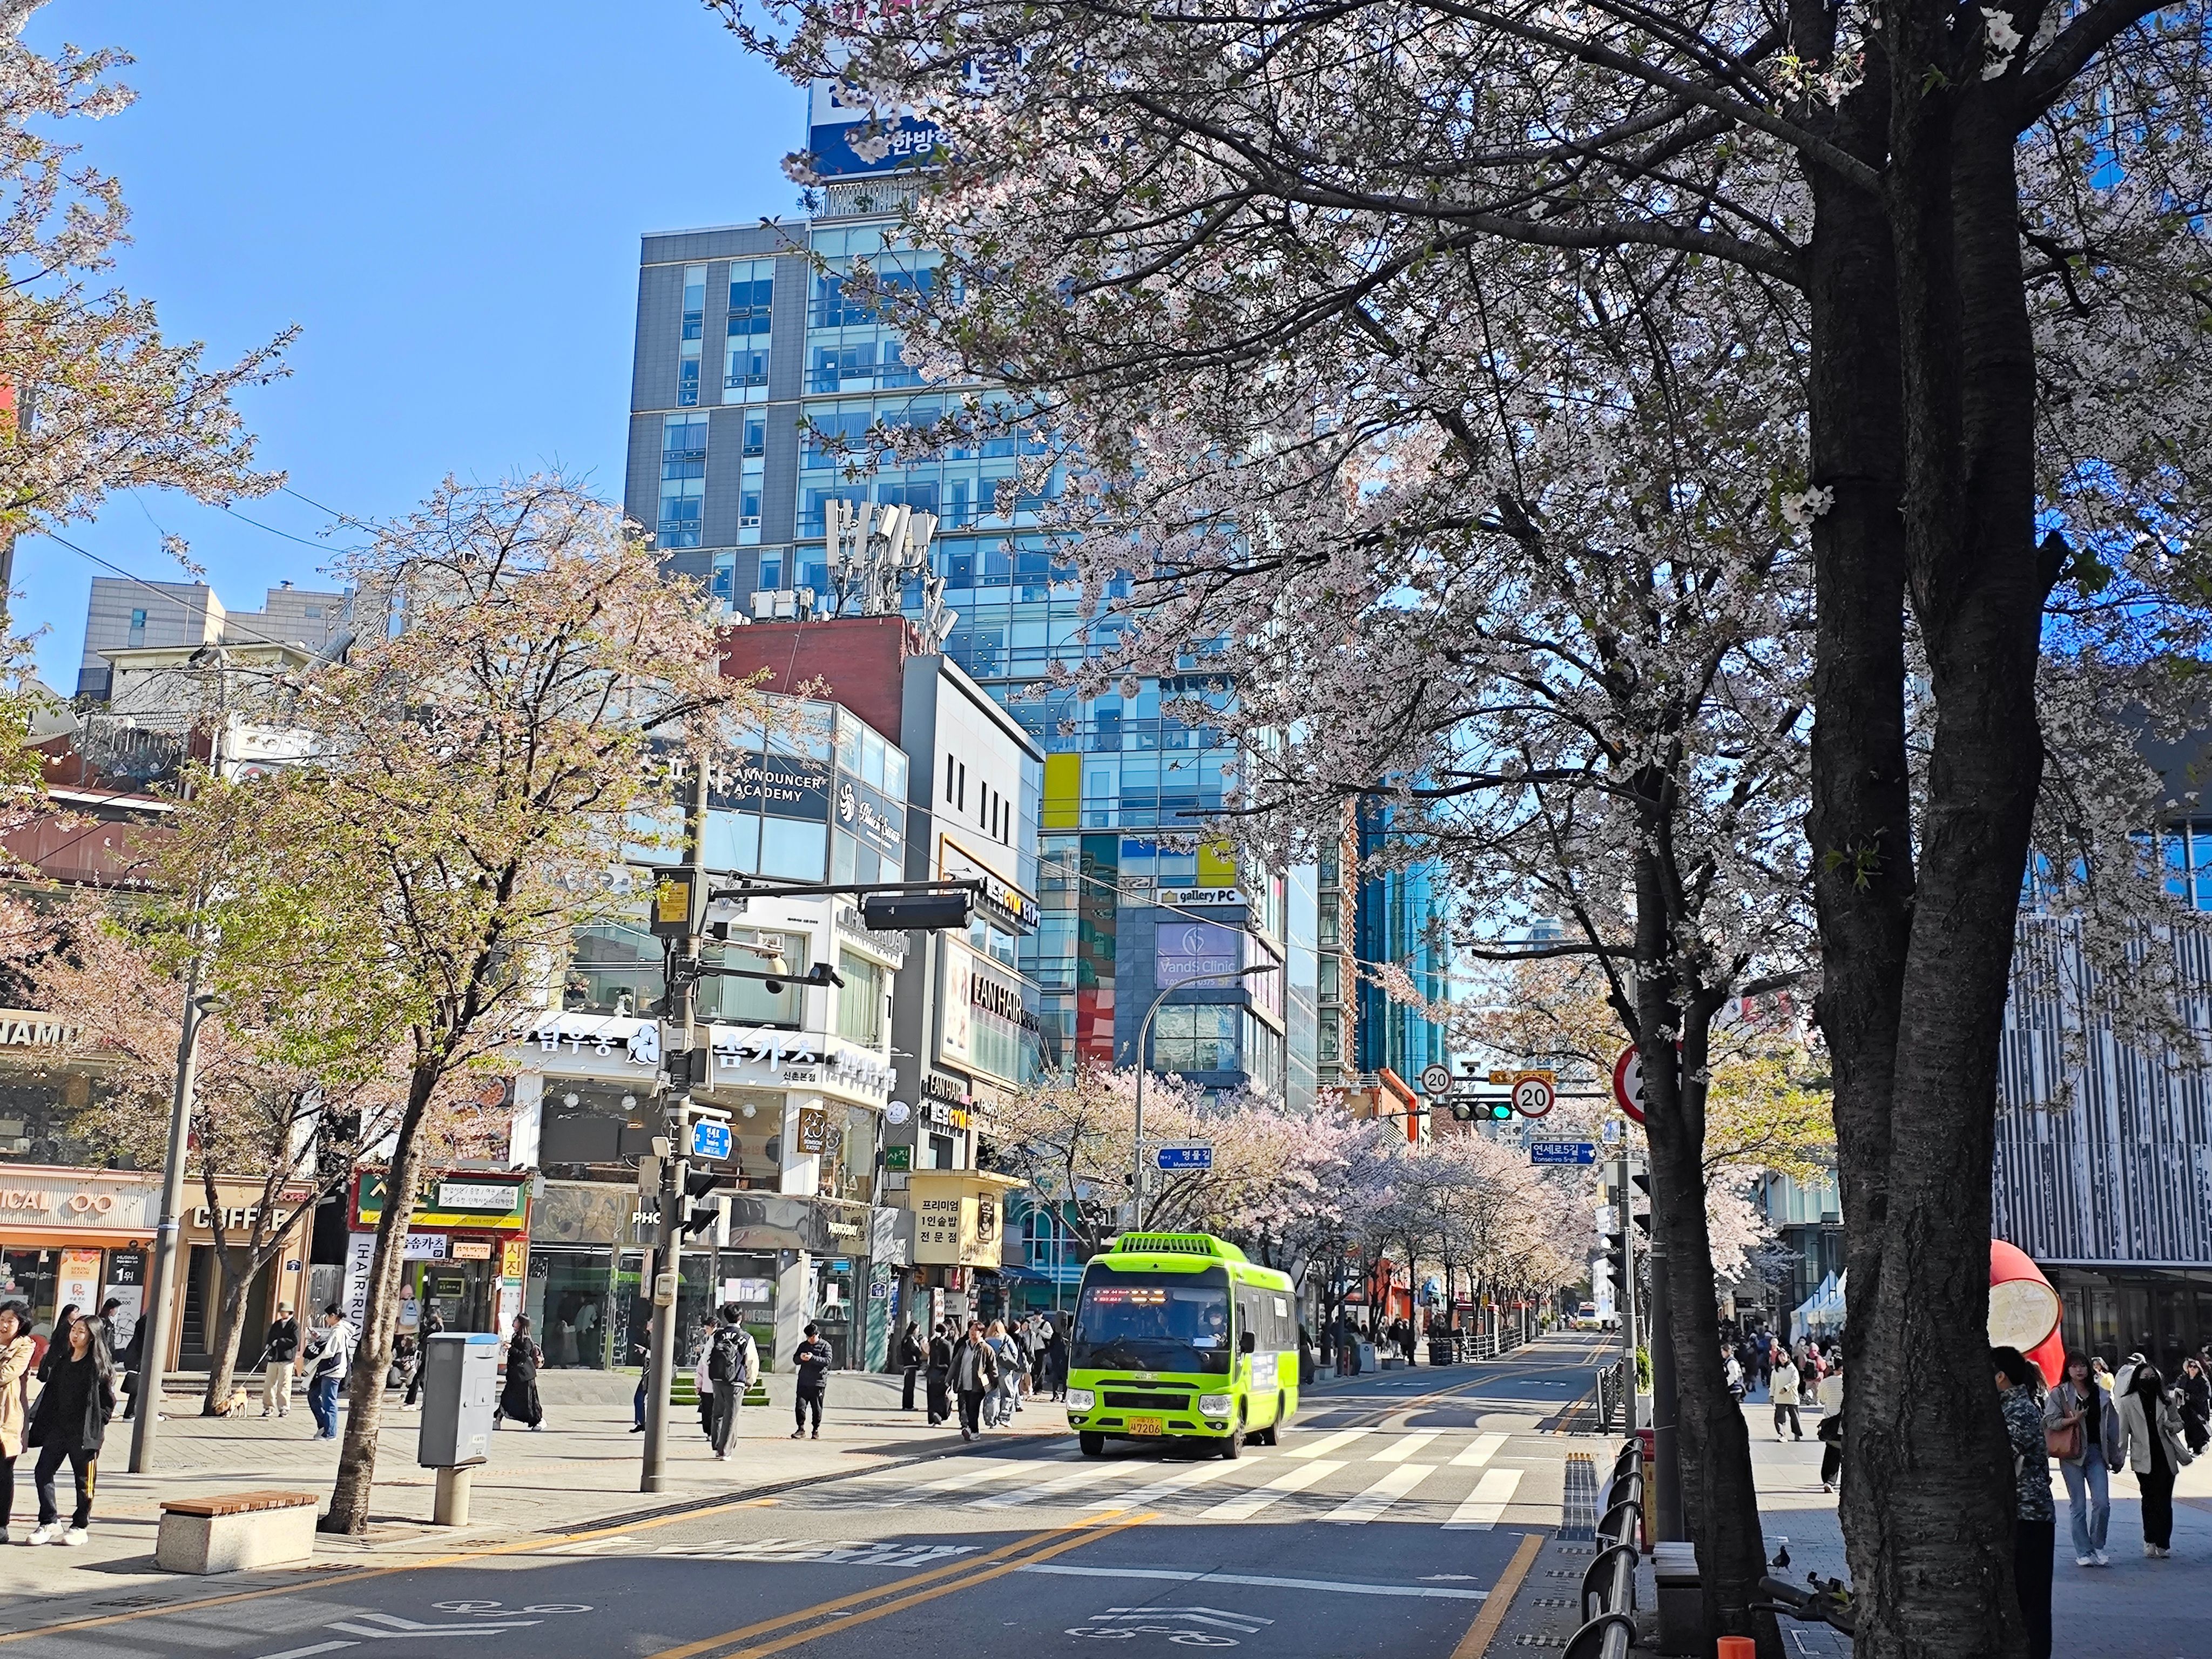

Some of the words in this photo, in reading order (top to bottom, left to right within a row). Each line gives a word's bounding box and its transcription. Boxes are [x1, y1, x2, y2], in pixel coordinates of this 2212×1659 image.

[734, 768, 820, 790] ANNOUNCER
[734, 784, 803, 802] ACADEMY
[1181, 890, 1216, 902] gallery
[1218, 890, 1235, 901] PC
[1160, 960, 1199, 973] VandS
[1202, 960, 1236, 973] Clinic
[974, 973, 995, 1013] EAN
[998, 984, 1022, 1025] HAIR
[524, 1022, 618, 1057] 림우동
[713, 1034, 817, 1073] 솜카츠
[783, 1071, 816, 1082] 신촌본점
[1428, 1073, 1446, 1087] 20
[930, 1074, 945, 1098] EAN
[946, 1080, 962, 1103] HAIR
[1521, 1088, 1546, 1106] 20
[887, 1150, 908, 1161] 사진
[1533, 1144, 1579, 1156] 연세로5길
[0, 1189, 50, 1210] ICAL
[922, 1200, 959, 1211] 프리미엄
[507, 1244, 524, 1276] 사진
[116, 1267, 134, 1282] 1위
